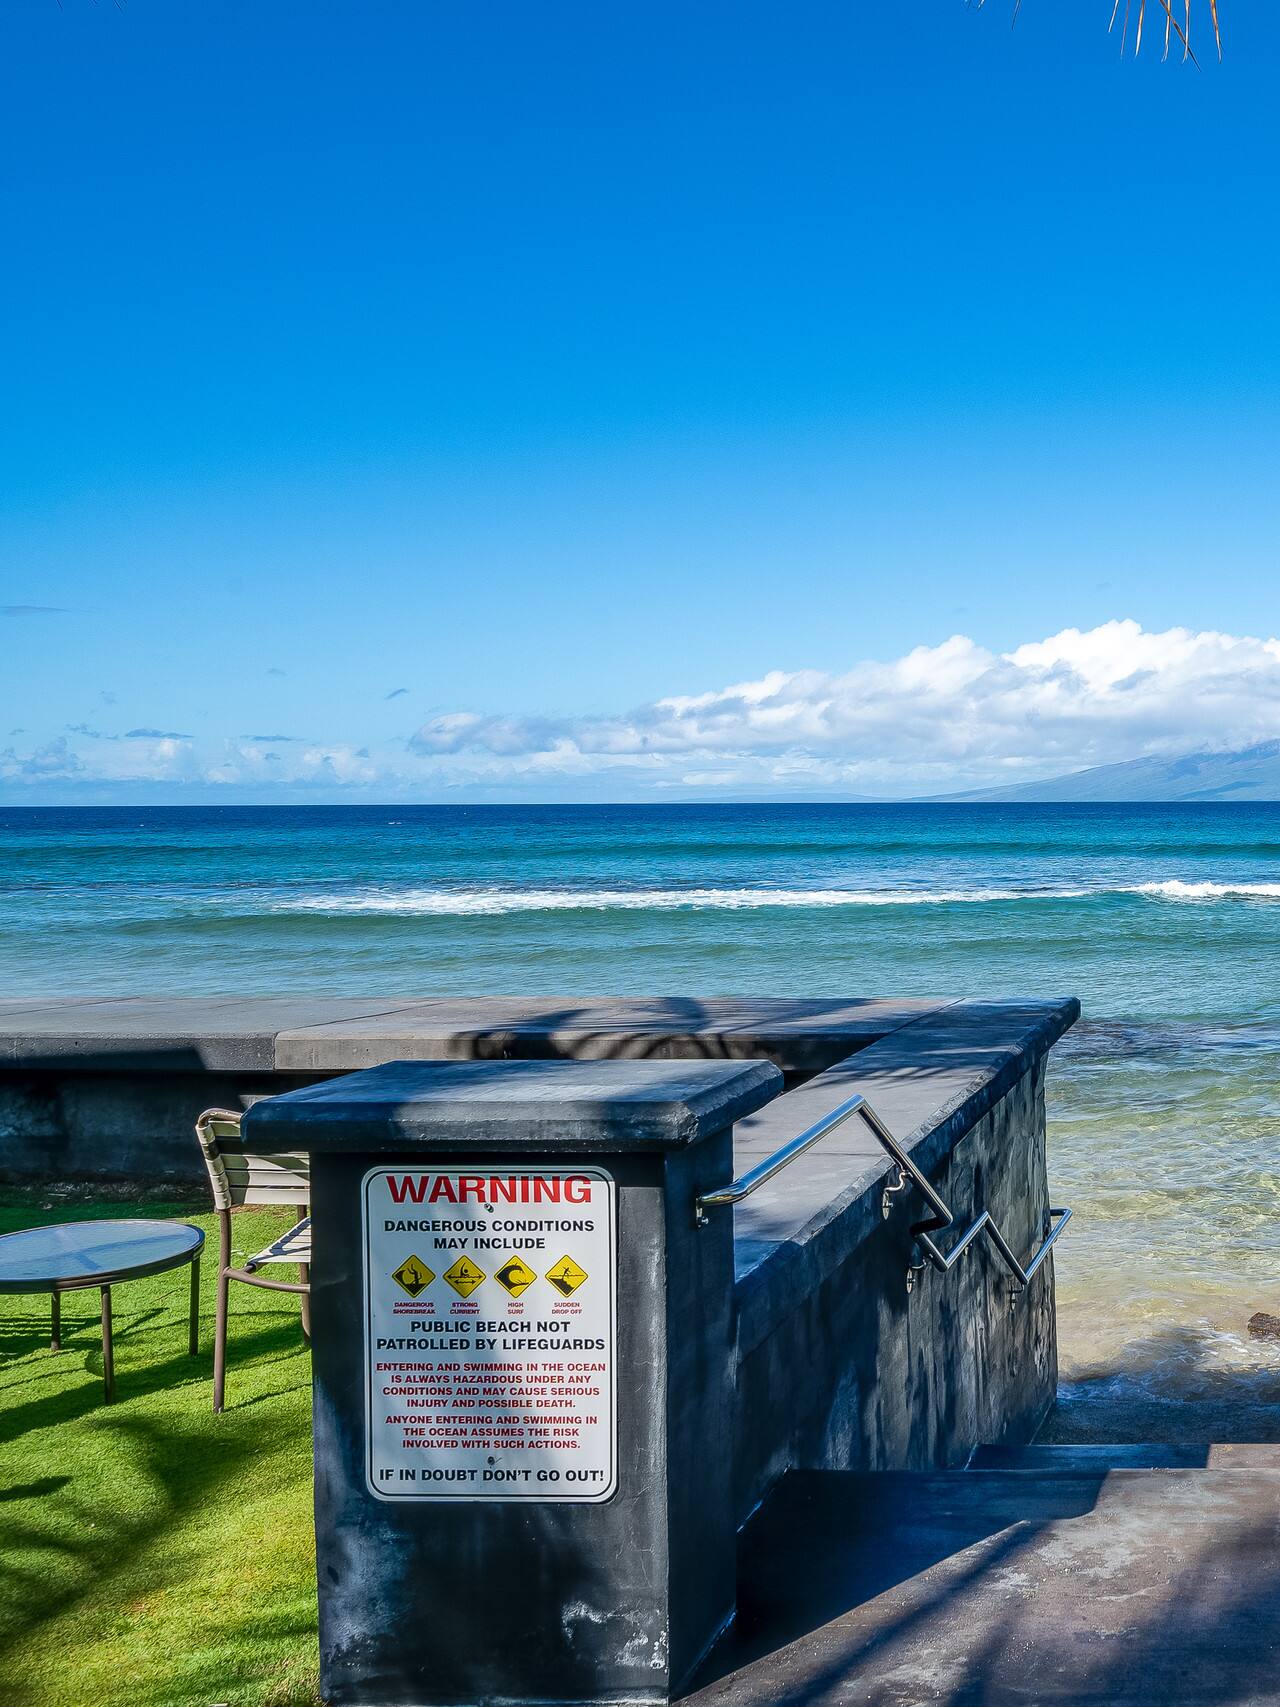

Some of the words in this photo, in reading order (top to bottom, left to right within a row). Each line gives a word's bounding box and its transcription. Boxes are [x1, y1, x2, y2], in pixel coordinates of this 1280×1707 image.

[386, 1175, 592, 1203] WARNING
[384, 1220, 487, 1232] DANGEROUS
[492, 1220, 594, 1232] CONDITIONS
[434, 1238, 468, 1249] MAY
[474, 1238, 545, 1249] INCLUDE
[410, 1321, 470, 1333] PUBLIC
[476, 1321, 530, 1333] BEACH
[537, 1321, 570, 1333] NOT
[377, 1339, 470, 1350] PATROLLED
[476, 1339, 497, 1350] BY
[502, 1339, 605, 1350] LIFEGUARDS
[376, 1363, 433, 1372] ENTERING
[437, 1363, 460, 1372] AND
[464, 1363, 523, 1372] SWIMMING
[526, 1363, 538, 1372] IN
[541, 1363, 564, 1372] THE
[567, 1363, 606, 1372] OCEAN
[391, 1375, 402, 1384] IS
[405, 1375, 449, 1384] ALWAYS
[453, 1375, 522, 1384] HAZARDOUS
[526, 1375, 564, 1384] UNDER
[568, 1375, 591, 1384] ANY
[383, 1387, 453, 1396] CONDITIONS
[456, 1387, 479, 1396] AND
[483, 1387, 506, 1396] MAY
[509, 1387, 547, 1396] CAUSE
[551, 1387, 600, 1396] SERIOUS
[407, 1399, 448, 1408] INJURY
[452, 1399, 475, 1408] AND
[478, 1399, 532, 1408] POSSIBLE
[536, 1399, 576, 1408] DEATH.
[386, 1416, 432, 1424] ANYONE
[436, 1416, 493, 1424] ENTERING
[496, 1416, 519, 1424] AND
[523, 1416, 582, 1424] SWIMMING
[586, 1416, 597, 1424] IN
[403, 1428, 425, 1436] THE
[429, 1428, 467, 1436] OCEAN
[471, 1428, 524, 1436] ASSUMES
[527, 1428, 550, 1436] THE
[553, 1428, 579, 1436] RISK
[403, 1440, 458, 1449] INVOLVED
[461, 1440, 490, 1449] WITH
[493, 1440, 524, 1449] SUCH
[527, 1440, 581, 1449] ACTIONS.
[379, 1469, 393, 1481] IF
[399, 1469, 416, 1481] IN
[422, 1469, 477, 1481] DOUBT
[536, 1469, 560, 1481] GO
[565, 1469, 604, 1481] OUT!
